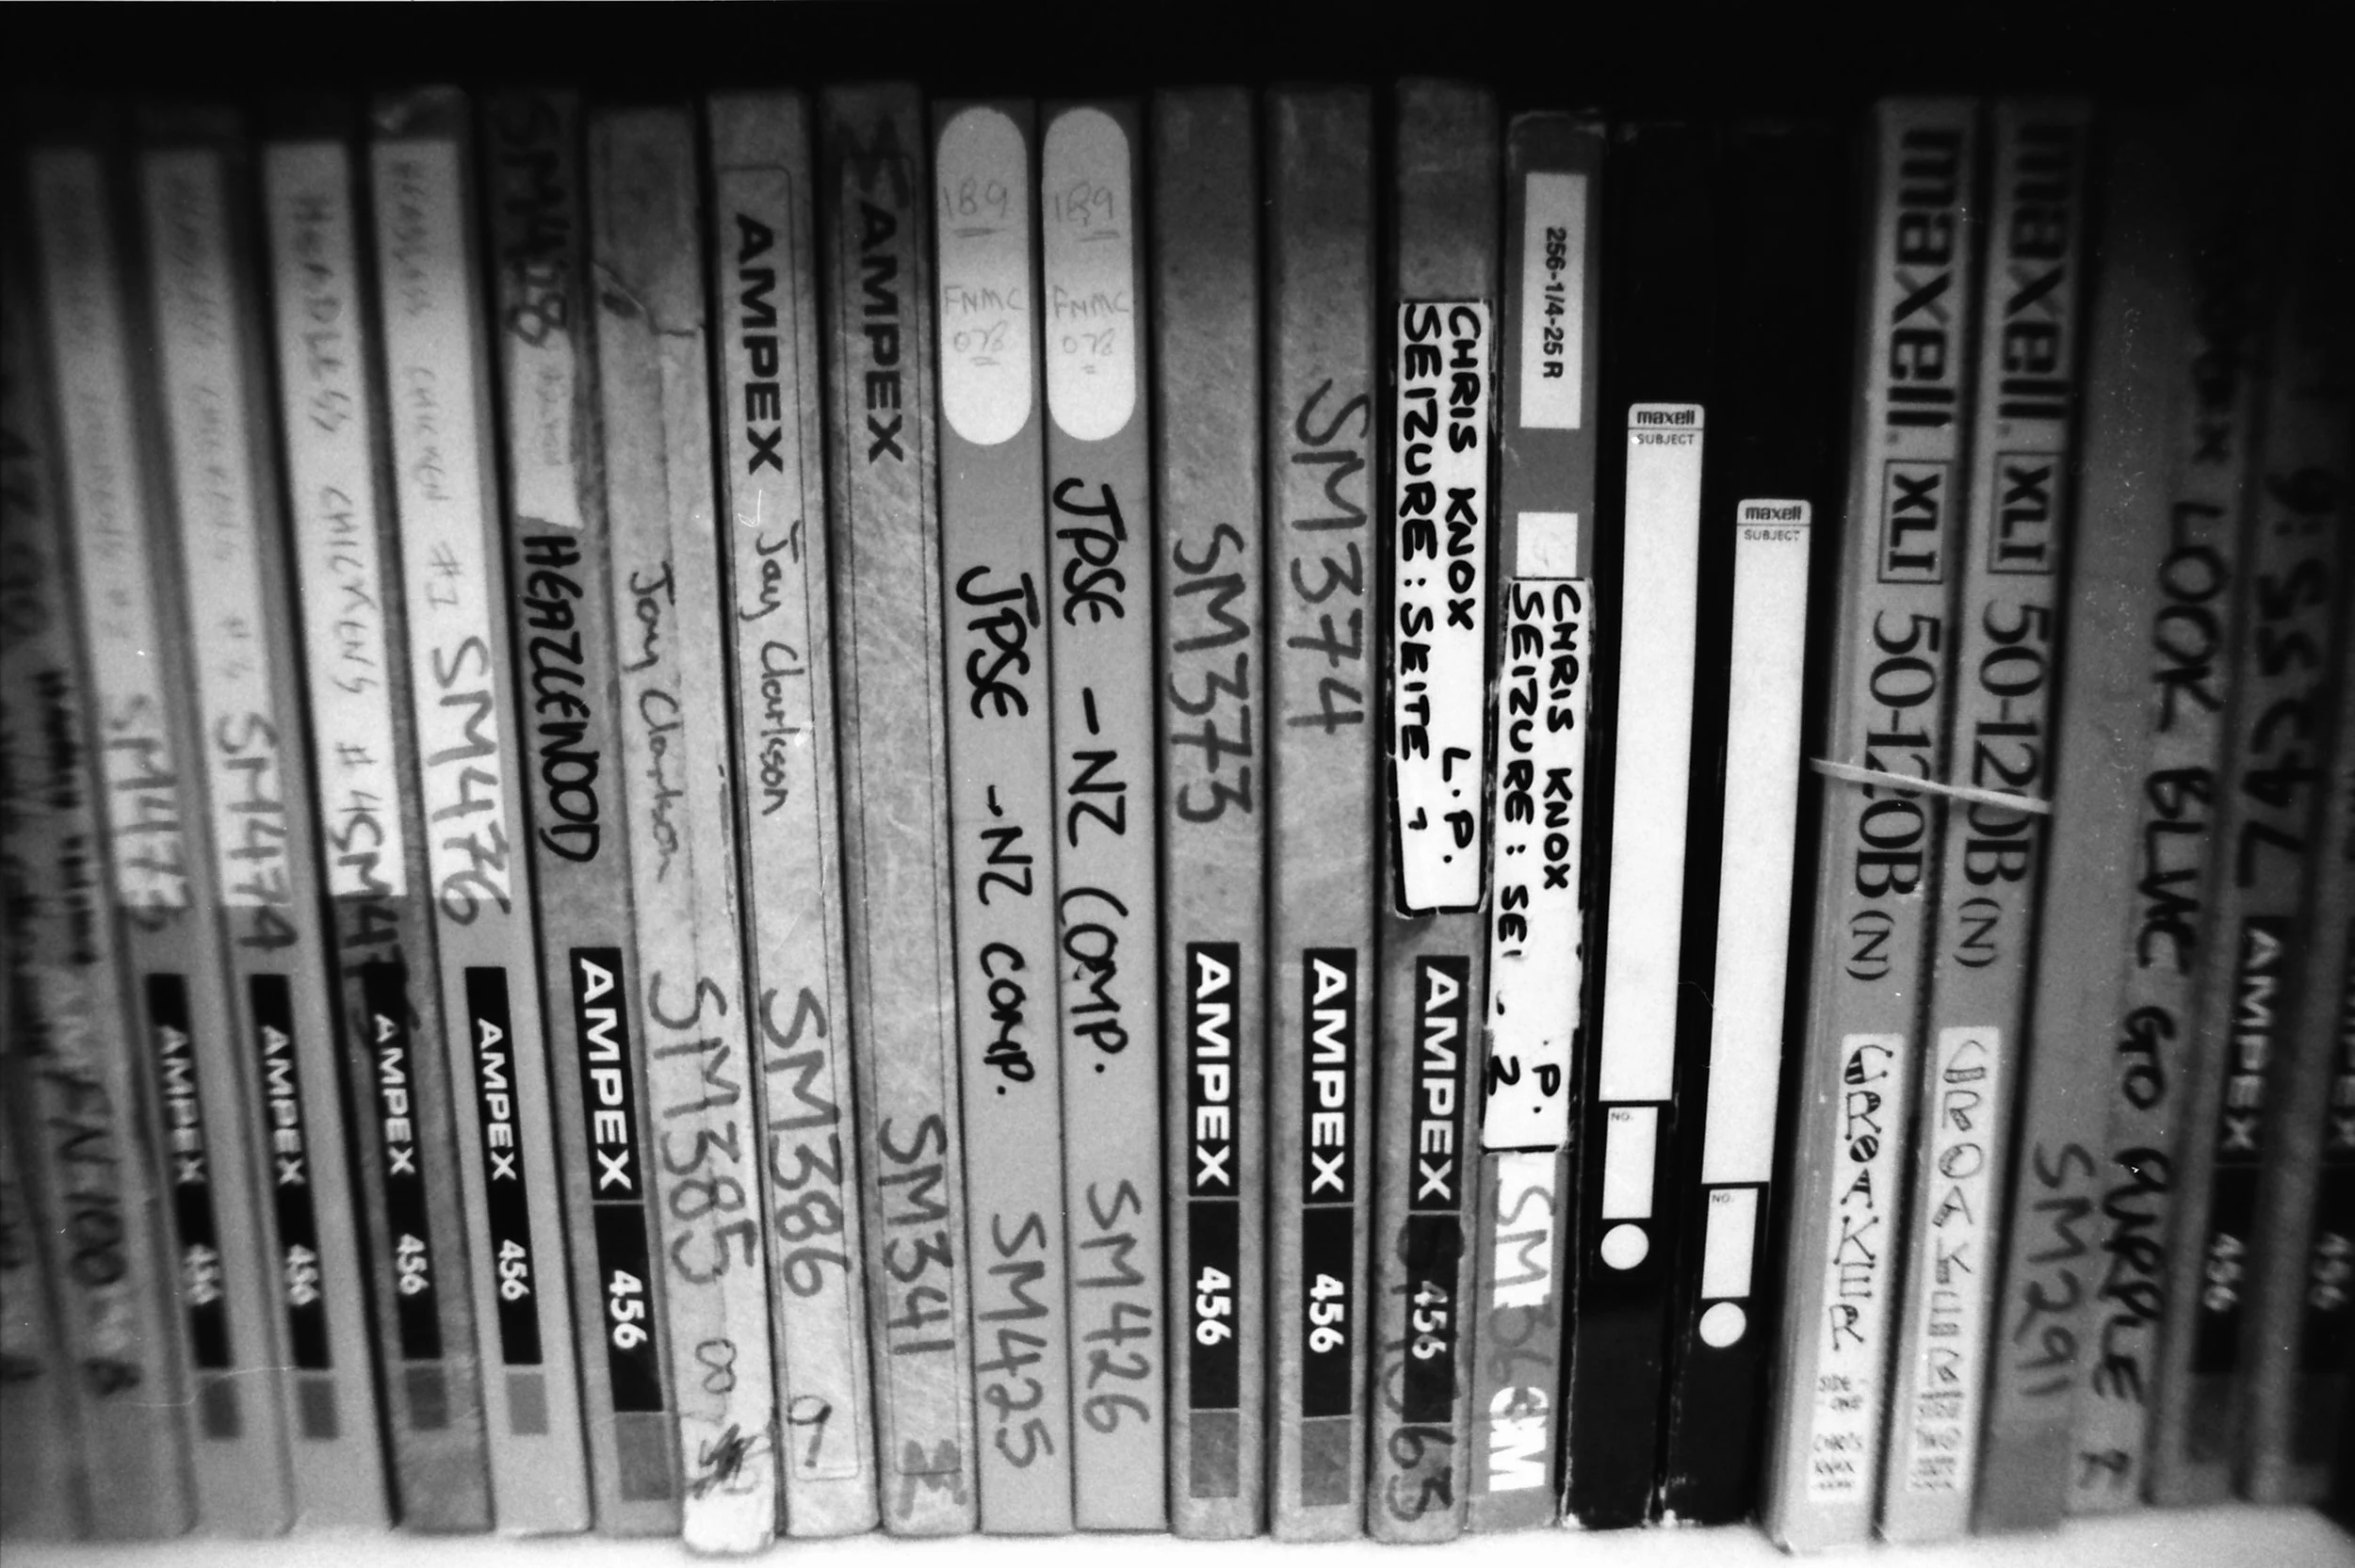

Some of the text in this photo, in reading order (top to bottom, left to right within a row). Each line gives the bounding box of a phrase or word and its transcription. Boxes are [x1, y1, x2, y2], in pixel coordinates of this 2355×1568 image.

[736, 213, 784, 477] AMPEX
[858, 200, 905, 465] AMPEX
[1886, 128, 1963, 429] maxell
[1998, 122, 2076, 422] maxell
[1447, 305, 1482, 454] CHRIS
[1635, 433, 1695, 445] SUBJECT
[1636, 410, 1696, 426] maxell
[1051, 477, 1129, 629] JPSE
[1286, 378, 1372, 736] SM374
[1444, 487, 1479, 632] KNOX
[1744, 528, 1801, 542] SUBJECT
[1745, 506, 1802, 521] maxell
[1887, 473, 1941, 571] XLI
[2001, 463, 2055, 562] XLI
[740, 520, 805, 816] Jay Clarkson
[952, 564, 1042, 720] JPSE
[1168, 522, 1254, 824] SM373
[1399, 602, 1431, 764] SEITE
[1547, 583, 1582, 736] CHRIS
[2153, 500, 2233, 734] LOOK
[426, 634, 512, 926] SM476
[1542, 767, 1573, 891] KNOX
[1844, 909, 1892, 981] (N)
[1953, 896, 2006, 968] (N)
[373, 1014, 415, 1176] AMPEX
[580, 959, 632, 1192] AMPEX
[978, 942, 1037, 1098] COMP.
[1194, 952, 1231, 1188] AMPEX
[1309, 958, 1348, 1195] AMPEX
[1418, 965, 1458, 1203] AMPEX
[1487, 1054, 1520, 1096] 2
[2116, 1006, 2177, 1111] GO
[2219, 927, 2284, 1151] AMPEX
[157, 1026, 203, 1186] AMPEX
[262, 1026, 304, 1186] AMPEX
[477, 1018, 517, 1181] AMPEX
[648, 972, 758, 1285] SM385
[758, 986, 853, 1299] SM386
[186, 1245, 220, 1305] 456
[284, 1245, 317, 1307] 456
[398, 1235, 427, 1294] 456
[499, 1239, 528, 1301] 456
[609, 1269, 645, 1349] 456
[877, 1112, 956, 1355] SM341
[1077, 1177, 1153, 1436] SM426
[1194, 1266, 1232, 1347] 456
[2012, 1141, 2097, 1399] SM291
[2206, 1233, 2247, 1312] 456
[977, 1211, 1057, 1472] SM425
[1308, 1272, 1344, 1354] 456
[1412, 1281, 1450, 1361] 456
[1488, 1386, 1551, 1492] 3M
